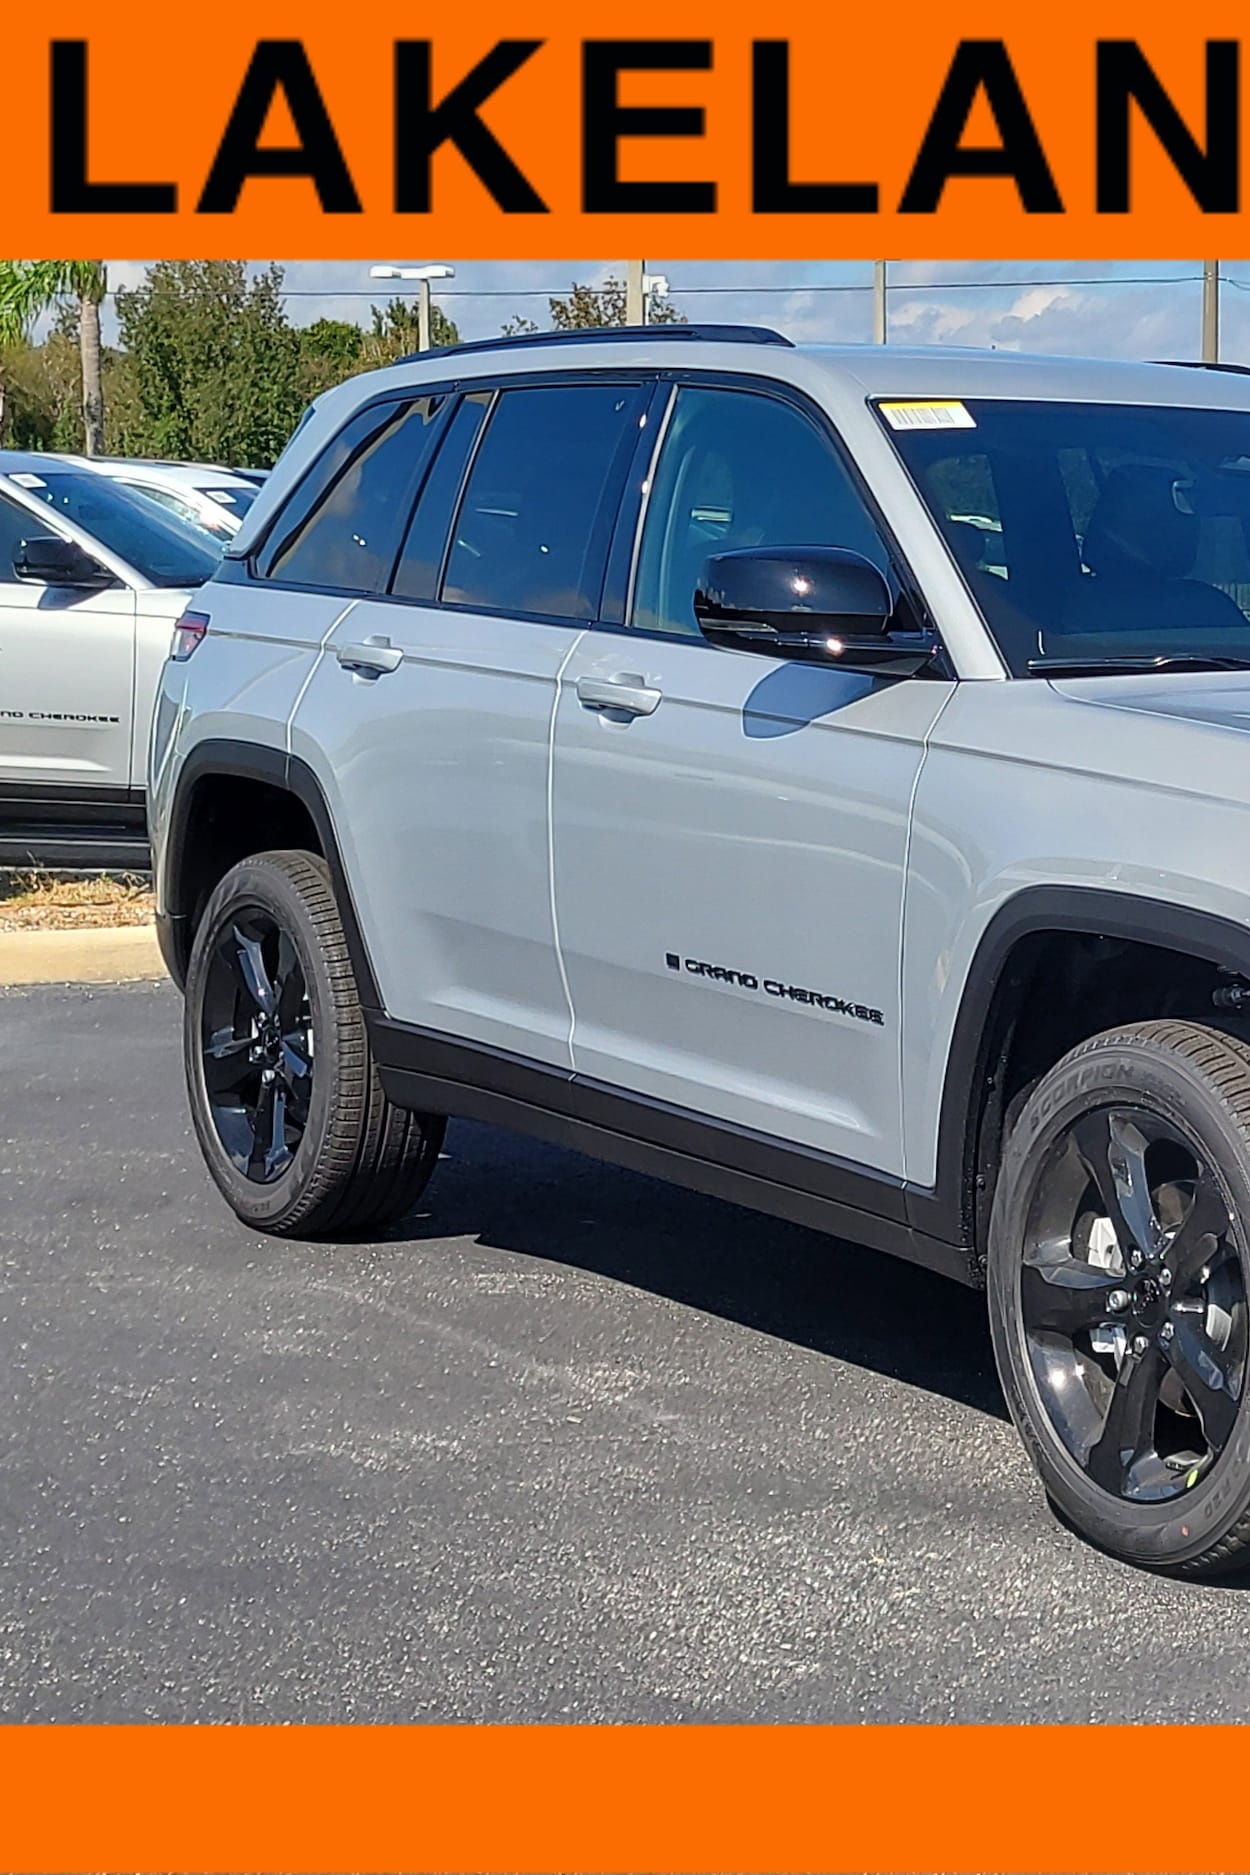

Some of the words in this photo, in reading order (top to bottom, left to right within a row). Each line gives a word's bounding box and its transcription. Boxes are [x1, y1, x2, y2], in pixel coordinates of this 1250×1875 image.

[28, 712, 120, 723] CHEROKEE
[684, 958, 759, 990] GRAND
[763, 980, 885, 1027] CHEROKEE
